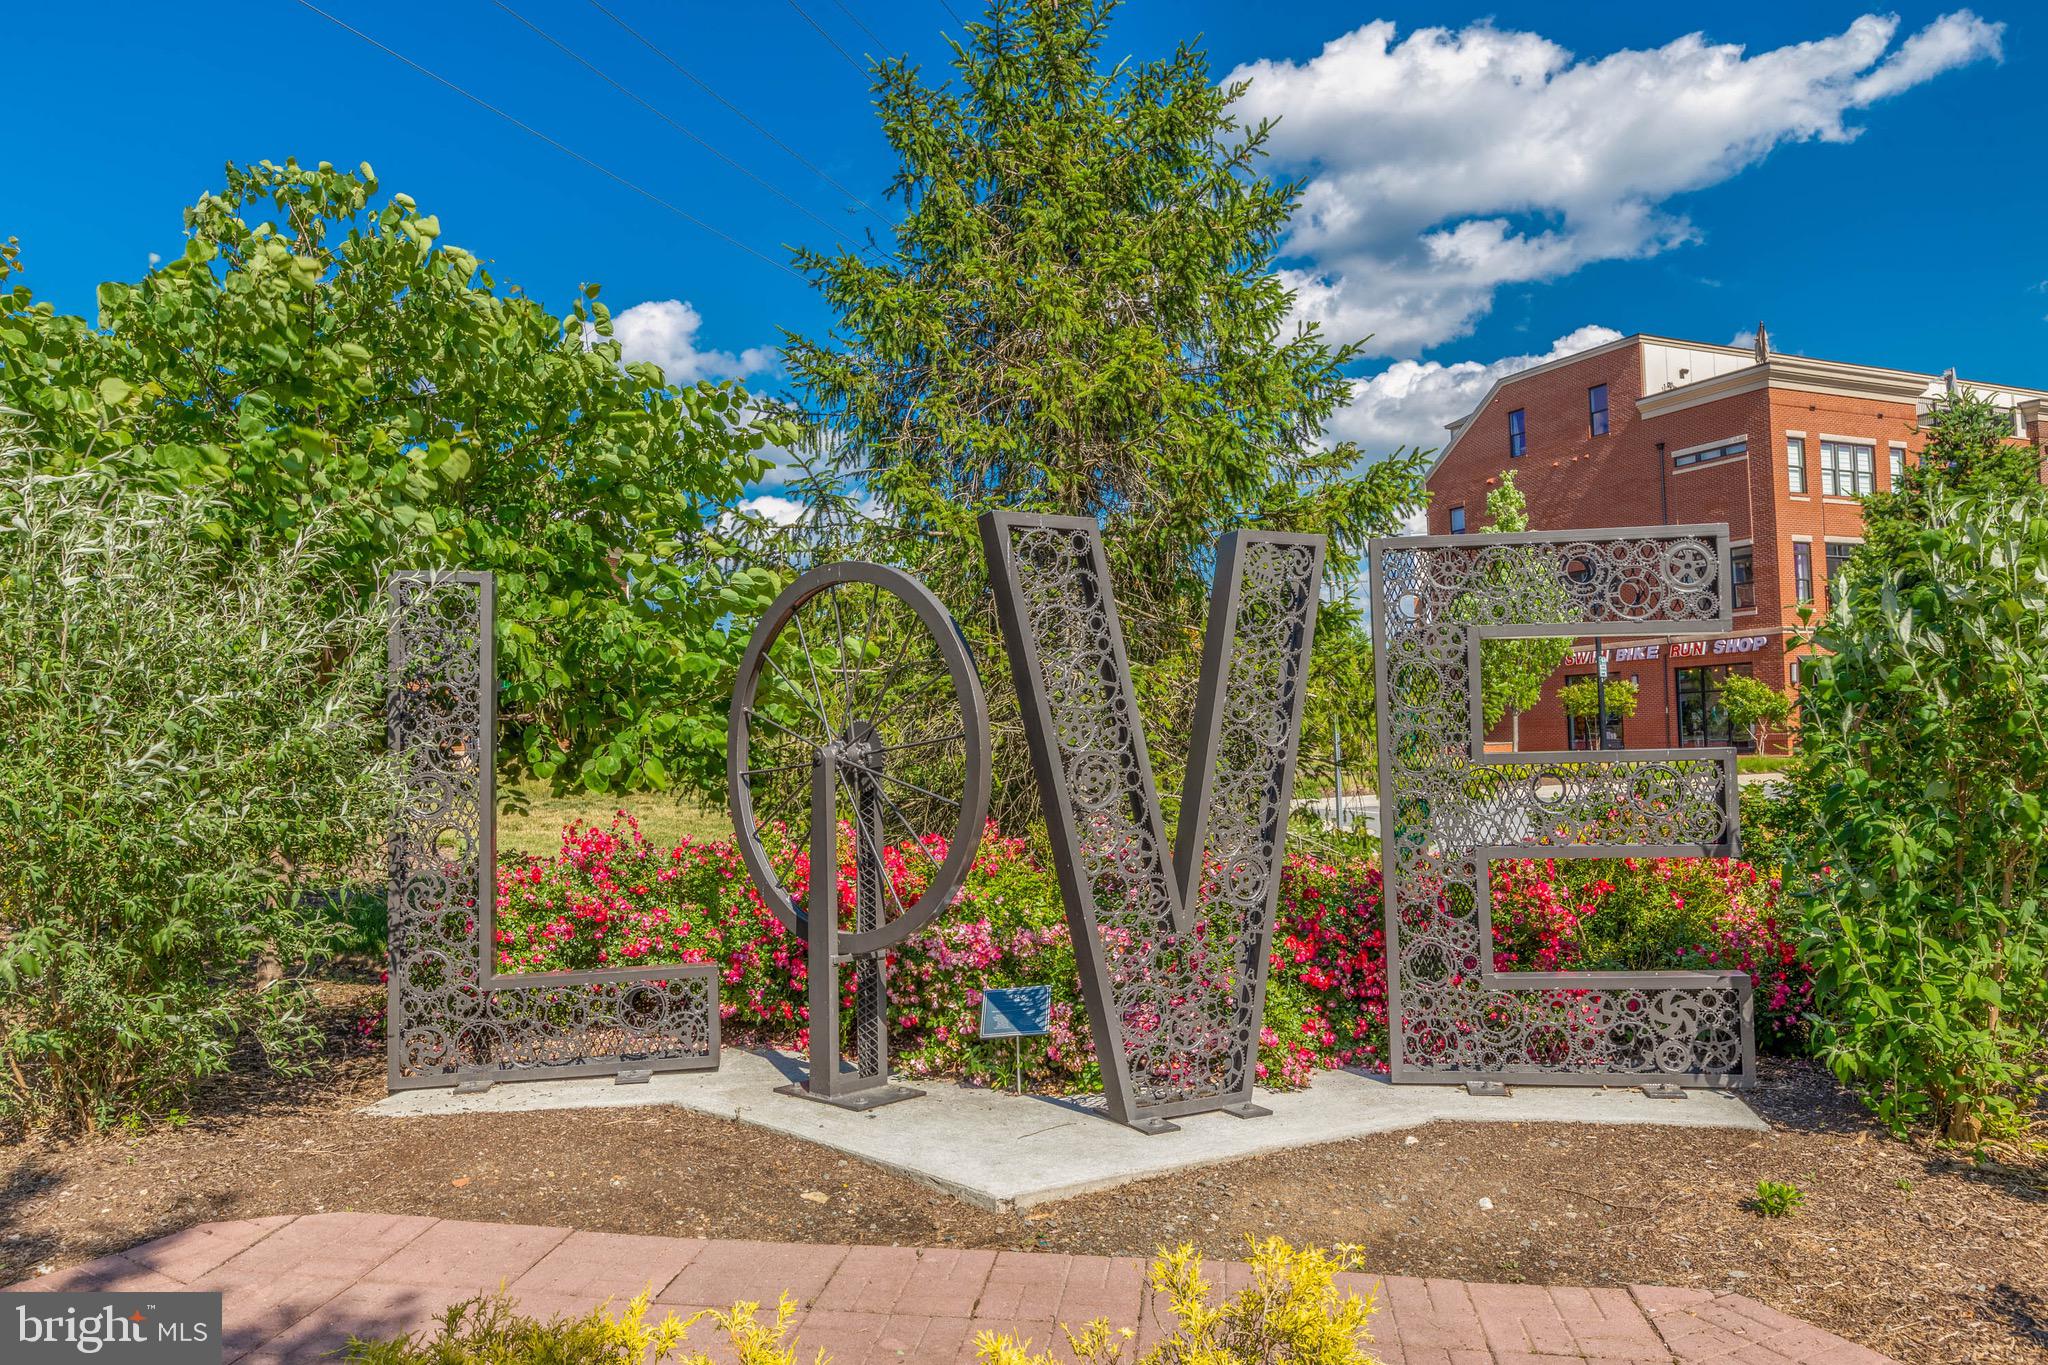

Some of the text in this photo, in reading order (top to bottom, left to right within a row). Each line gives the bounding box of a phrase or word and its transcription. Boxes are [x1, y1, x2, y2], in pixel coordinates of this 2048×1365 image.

[1616, 645, 1659, 661] BIKE
[1670, 641, 1706, 657] RUN
[1713, 636, 1767, 654] SHOP
